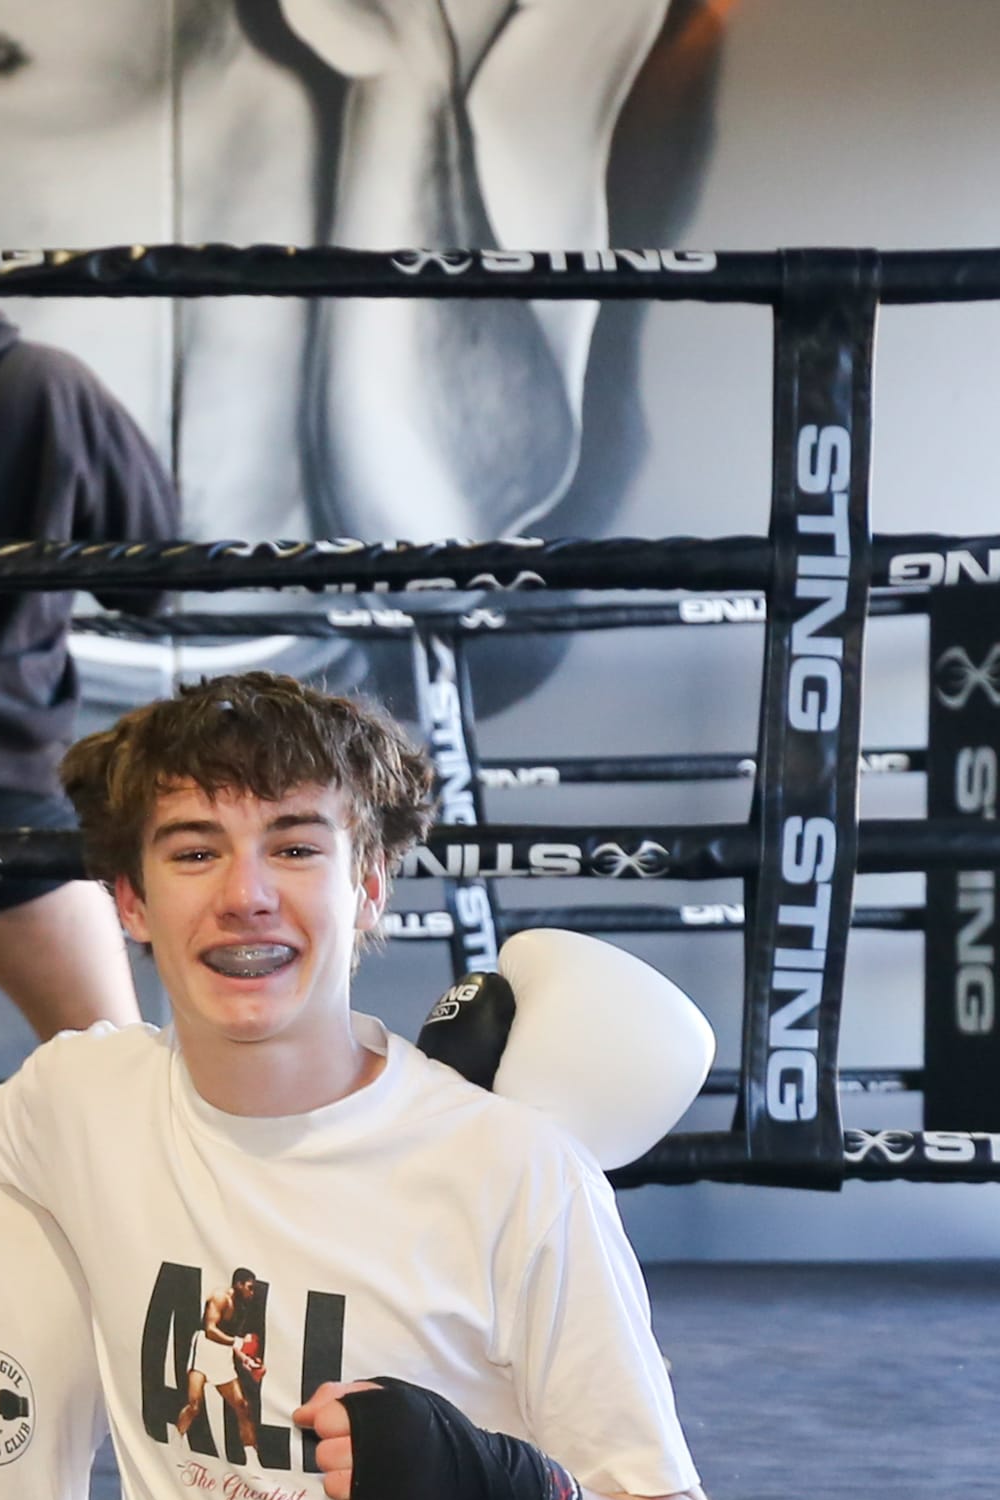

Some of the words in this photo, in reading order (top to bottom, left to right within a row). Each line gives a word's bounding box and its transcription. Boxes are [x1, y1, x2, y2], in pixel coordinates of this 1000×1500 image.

[788, 423, 851, 733] STING
[766, 816, 837, 1122] STING
[956, 746, 998, 1034] SING
[4, 1422, 31, 1454] CLUB
[141, 1261, 346, 1473] ALI
[176, 1459, 217, 1491] The
